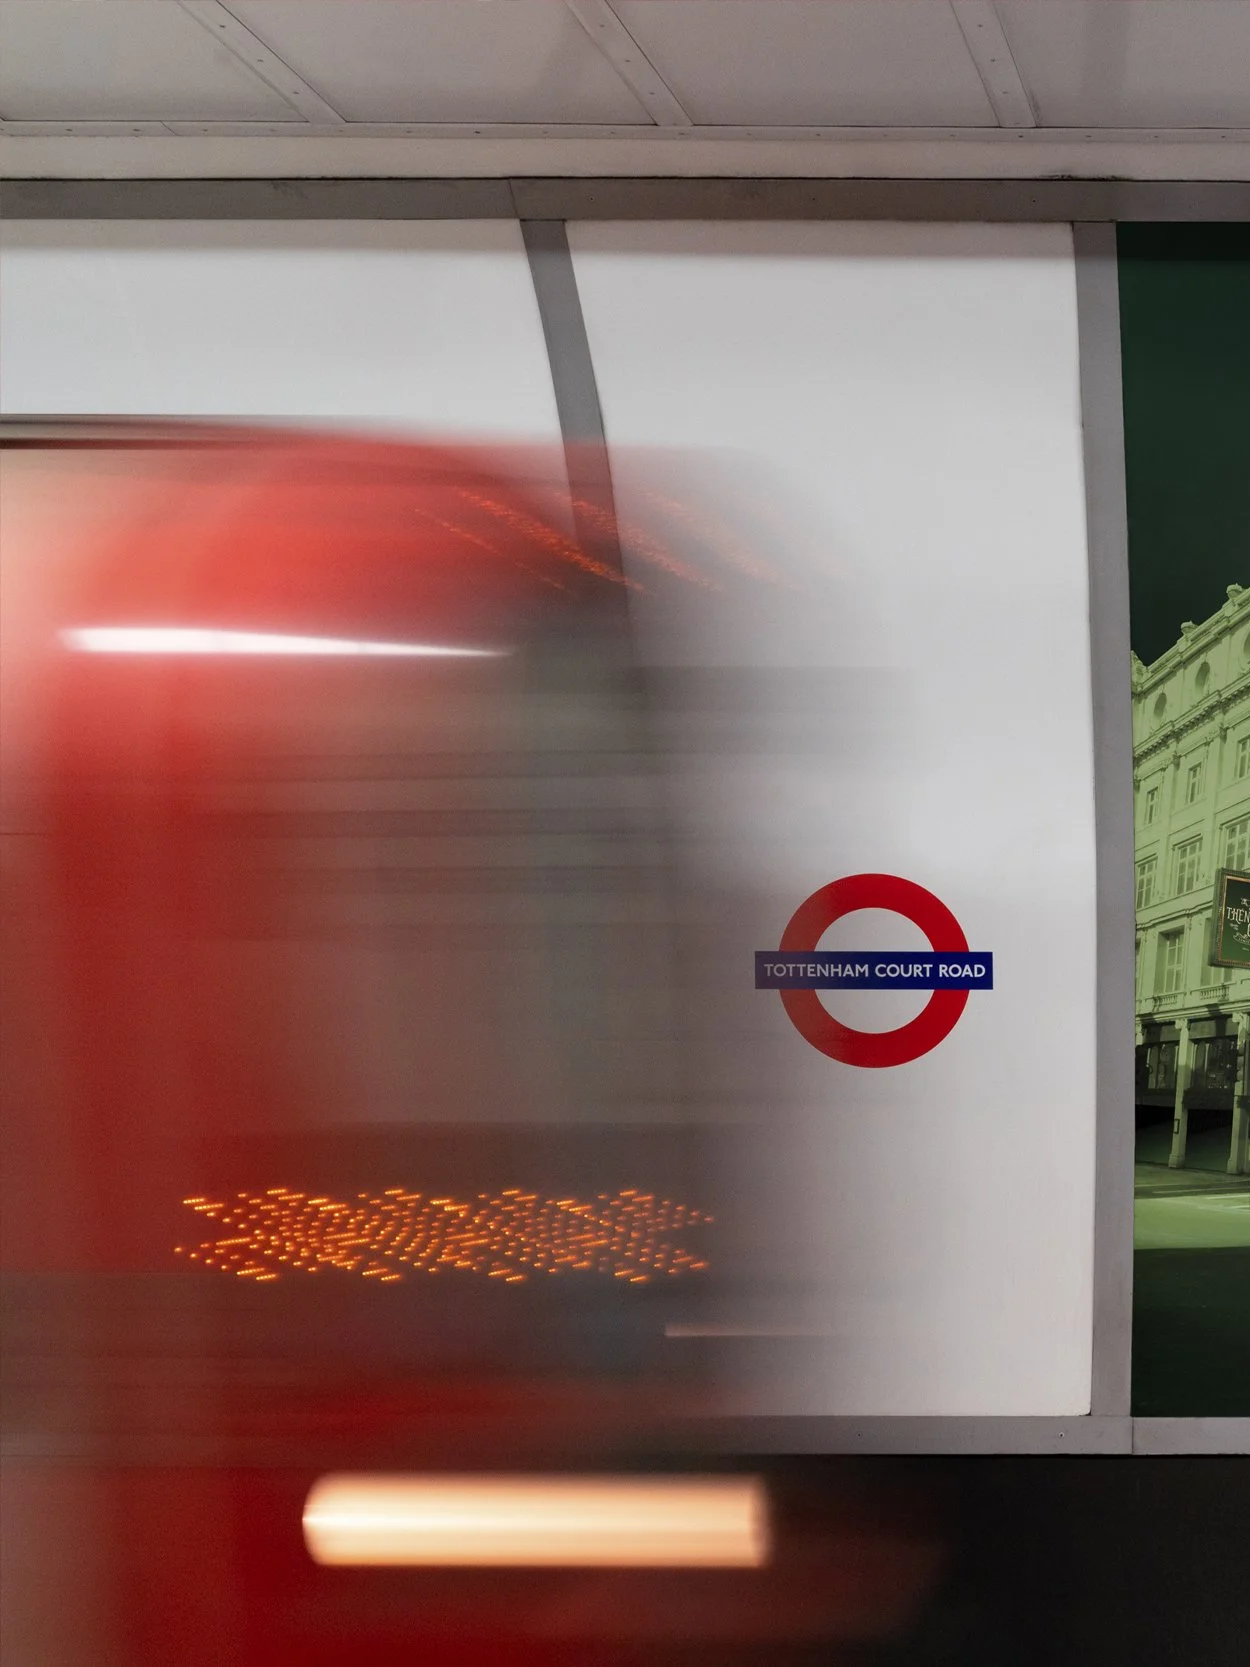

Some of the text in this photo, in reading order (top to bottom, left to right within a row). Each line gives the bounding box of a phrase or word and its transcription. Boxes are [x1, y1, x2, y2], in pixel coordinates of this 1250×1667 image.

[764, 963, 986, 978] TOTTENHAM COURT ROAD
